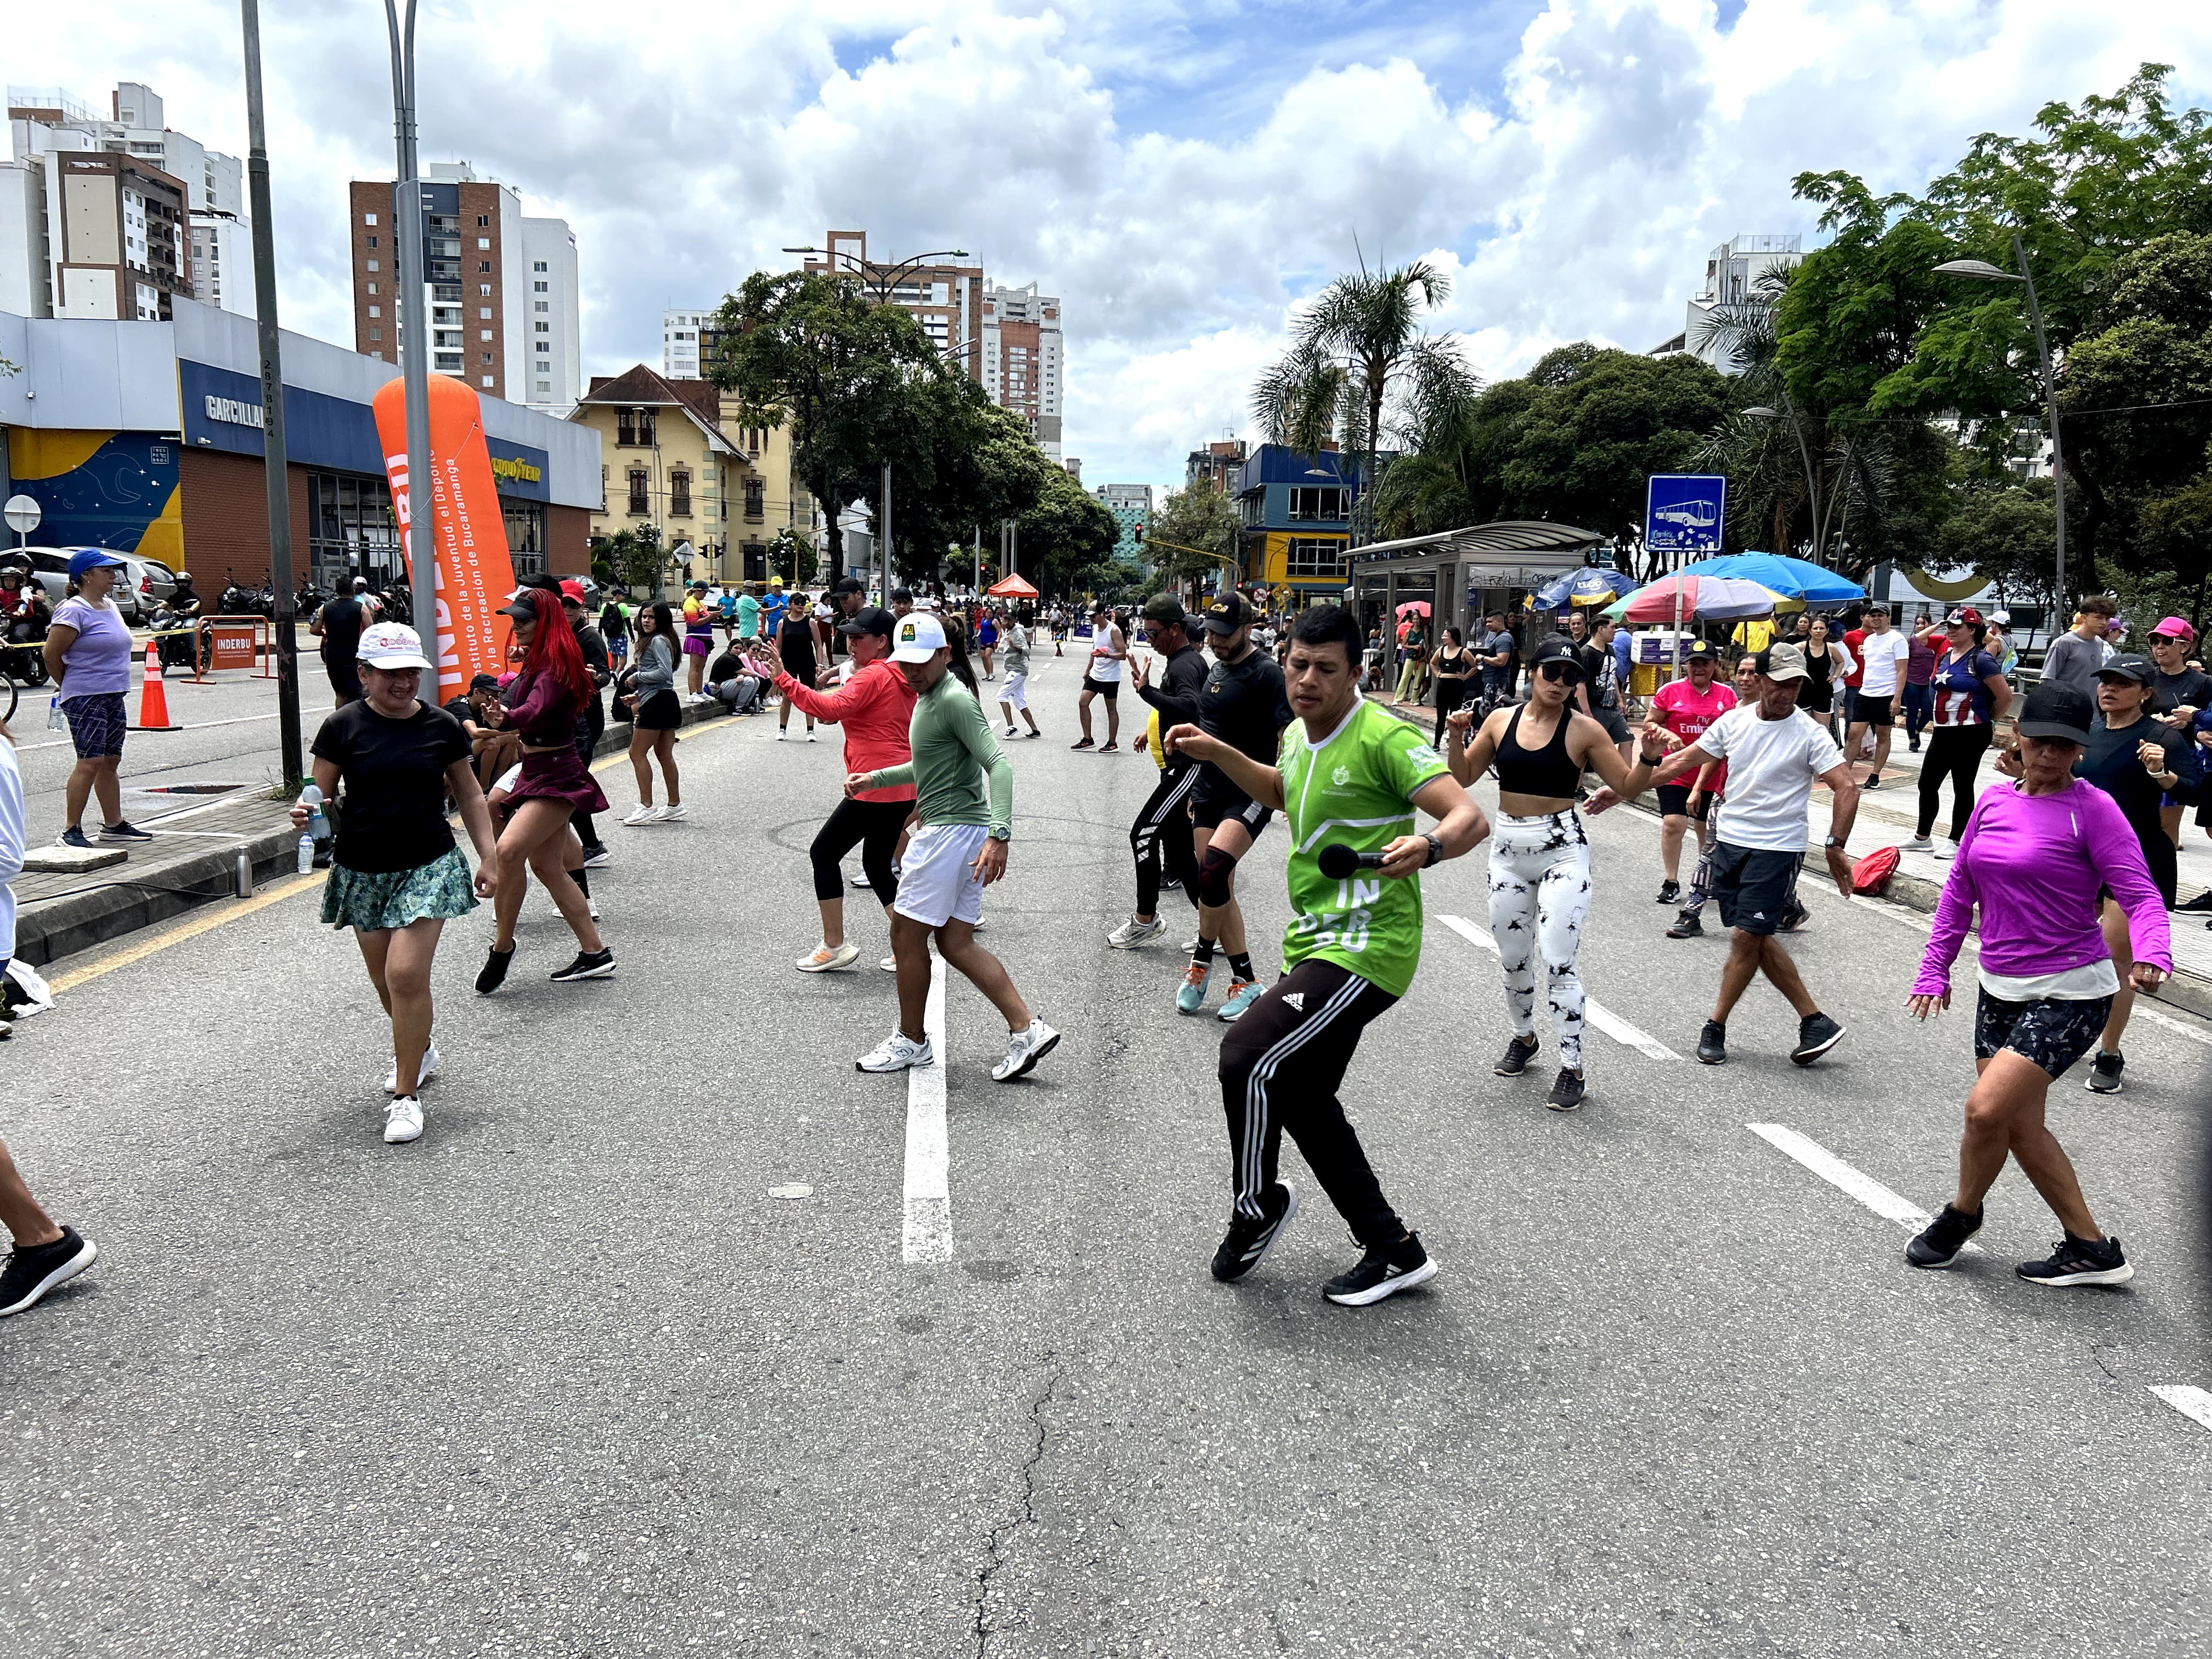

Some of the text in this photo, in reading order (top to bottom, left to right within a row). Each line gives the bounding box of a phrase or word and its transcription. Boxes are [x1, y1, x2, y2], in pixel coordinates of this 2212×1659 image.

[446, 459, 475, 547] Bucaramanga
[437, 506, 450, 517] el
[442, 522, 465, 586] Juventud,
[467, 551, 479, 567] de
[458, 590, 469, 602] la
[461, 606, 472, 621] de
[472, 571, 494, 644] Recreación
[217, 638, 251, 650] INDERBU
[466, 625, 482, 676] nstituto
[487, 647, 496, 658] la
[1696, 716, 1711, 724] Fly
[1336, 878, 1380, 909] IN
